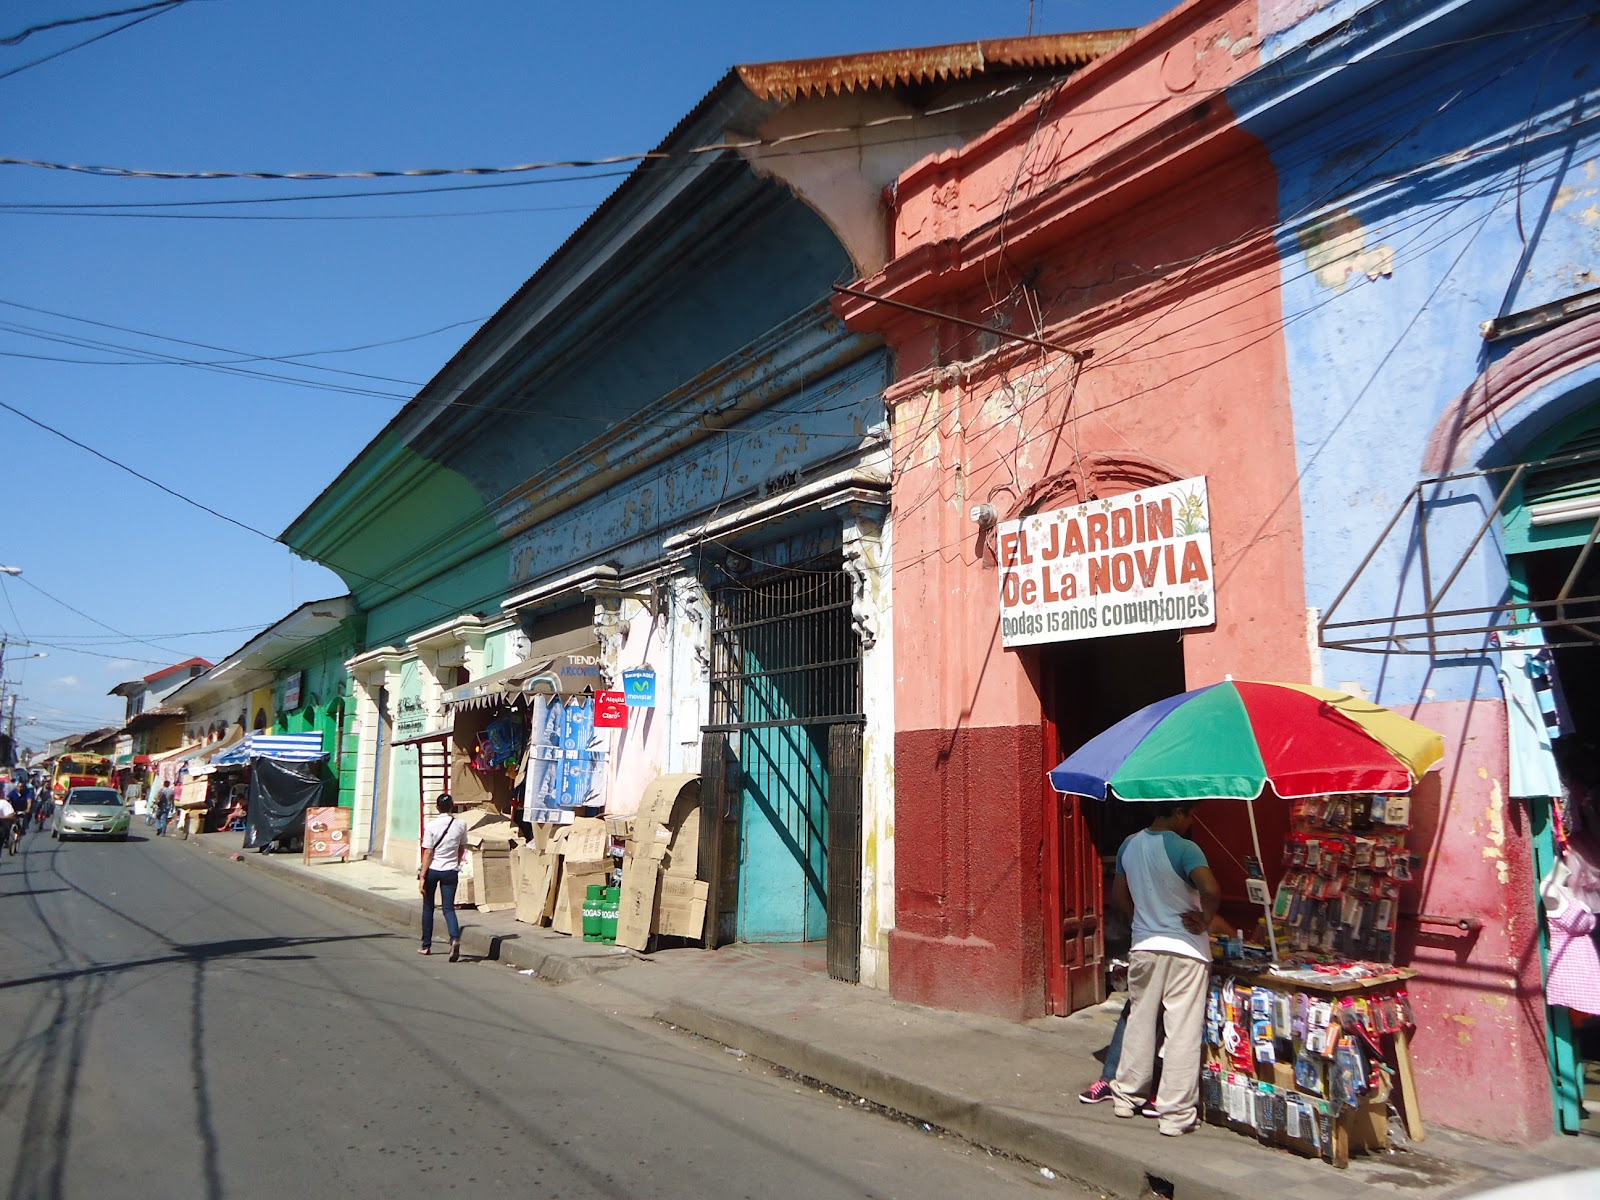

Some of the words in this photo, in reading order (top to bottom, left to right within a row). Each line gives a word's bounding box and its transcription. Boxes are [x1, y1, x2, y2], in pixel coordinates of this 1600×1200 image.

[1001, 529, 1034, 568] EL
[1003, 572, 1037, 608] De
[1042, 566, 1077, 604] La
[1088, 540, 1209, 596] NOVIA
[1046, 611, 1060, 633] 15
[1061, 605, 1097, 631] años
[1101, 591, 1209, 627] comuniones
[602, 711, 619, 720] Claro
